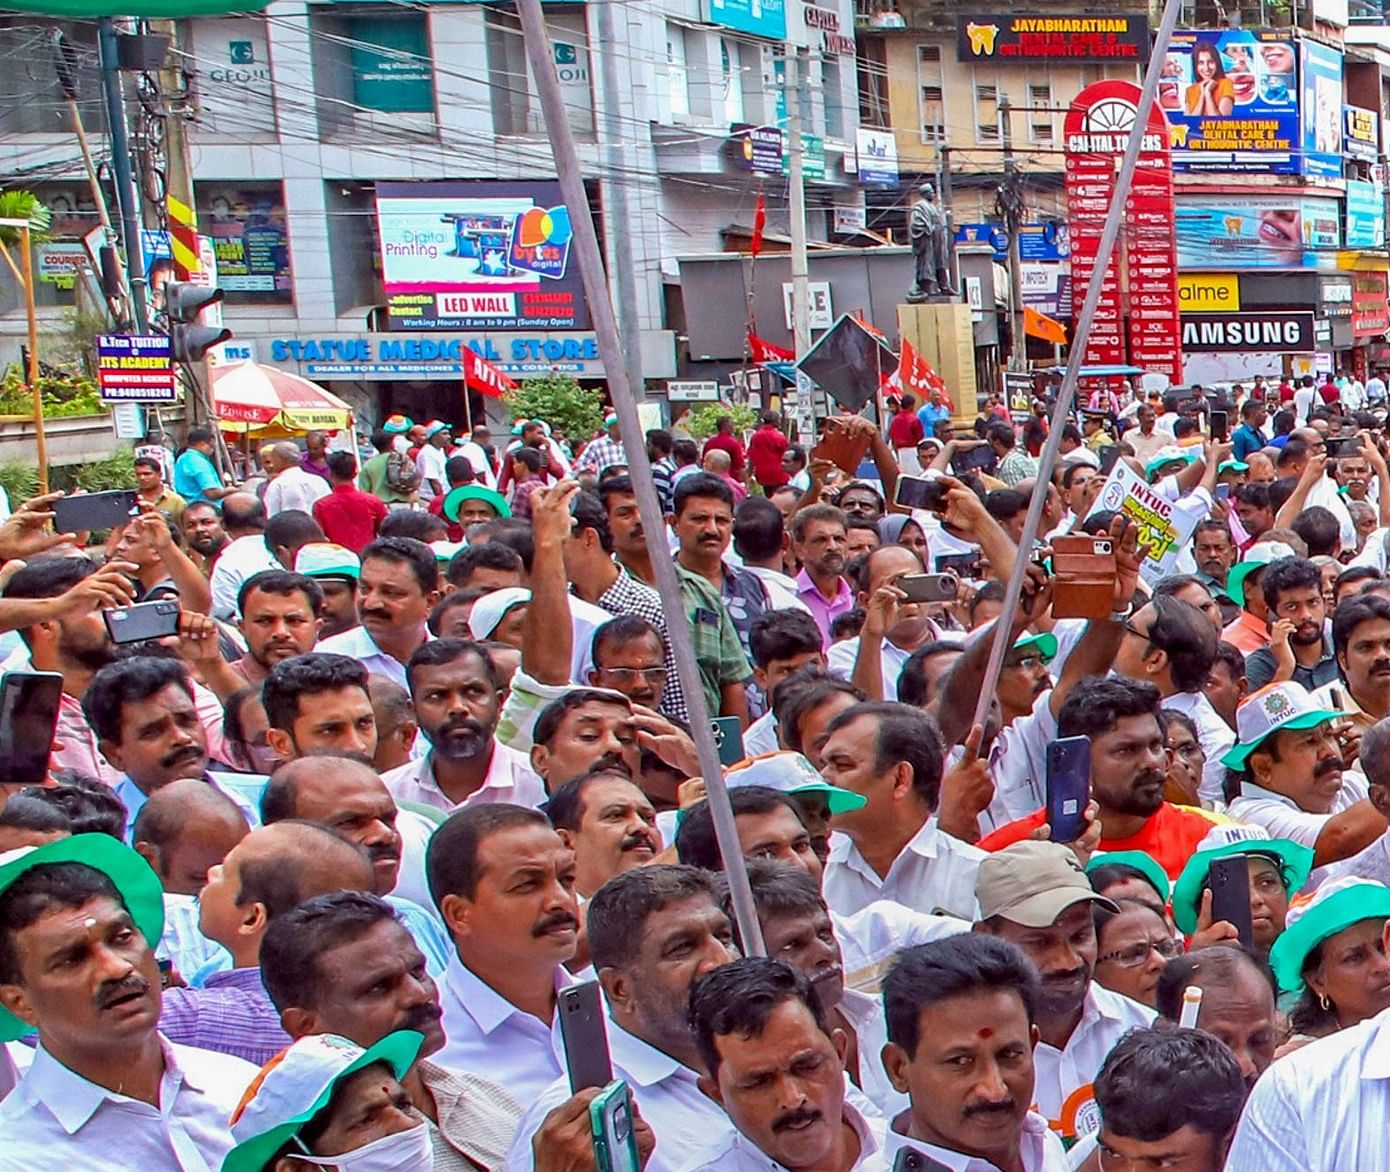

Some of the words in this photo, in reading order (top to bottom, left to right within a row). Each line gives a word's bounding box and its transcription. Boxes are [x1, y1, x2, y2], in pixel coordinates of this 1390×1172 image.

[1011, 19, 1128, 32] JAYABHARATHAM
[1200, 120, 1279, 131] JAYABHARATHAM
[1203, 131, 1238, 140] DENTAL
[1242, 131, 1265, 140] CARE
[1189, 139, 1253, 150] ORTHODONTIC
[404, 230, 447, 248] Digital
[386, 243, 438, 258] Printing
[513, 245, 560, 269] bytes
[44, 256, 86, 264] COURIER
[532, 258, 562, 270] digital
[1178, 284, 1230, 300] alme
[445, 298, 468, 312] LED
[472, 298, 510, 312] WALL
[403, 318, 435, 328] Working
[437, 318, 459, 327] Hours
[517, 318, 549, 327] (Sunday
[550, 318, 574, 327] Open)
[1183, 321, 1301, 345] AMSUNG
[129, 336, 169, 348] TUITION
[224, 346, 251, 359] ms
[271, 340, 377, 362] STATUE
[379, 339, 500, 362] MEDICAL
[511, 339, 598, 361] STORE
[120, 357, 170, 369] ACADEMY
[313, 365, 357, 373] DEALER
[359, 365, 379, 373] FOR
[381, 365, 398, 373] ALL
[398, 364, 453, 373] MEDICINES
[1130, 481, 1172, 518] INTUC
[1270, 707, 1297, 726] INTUC
